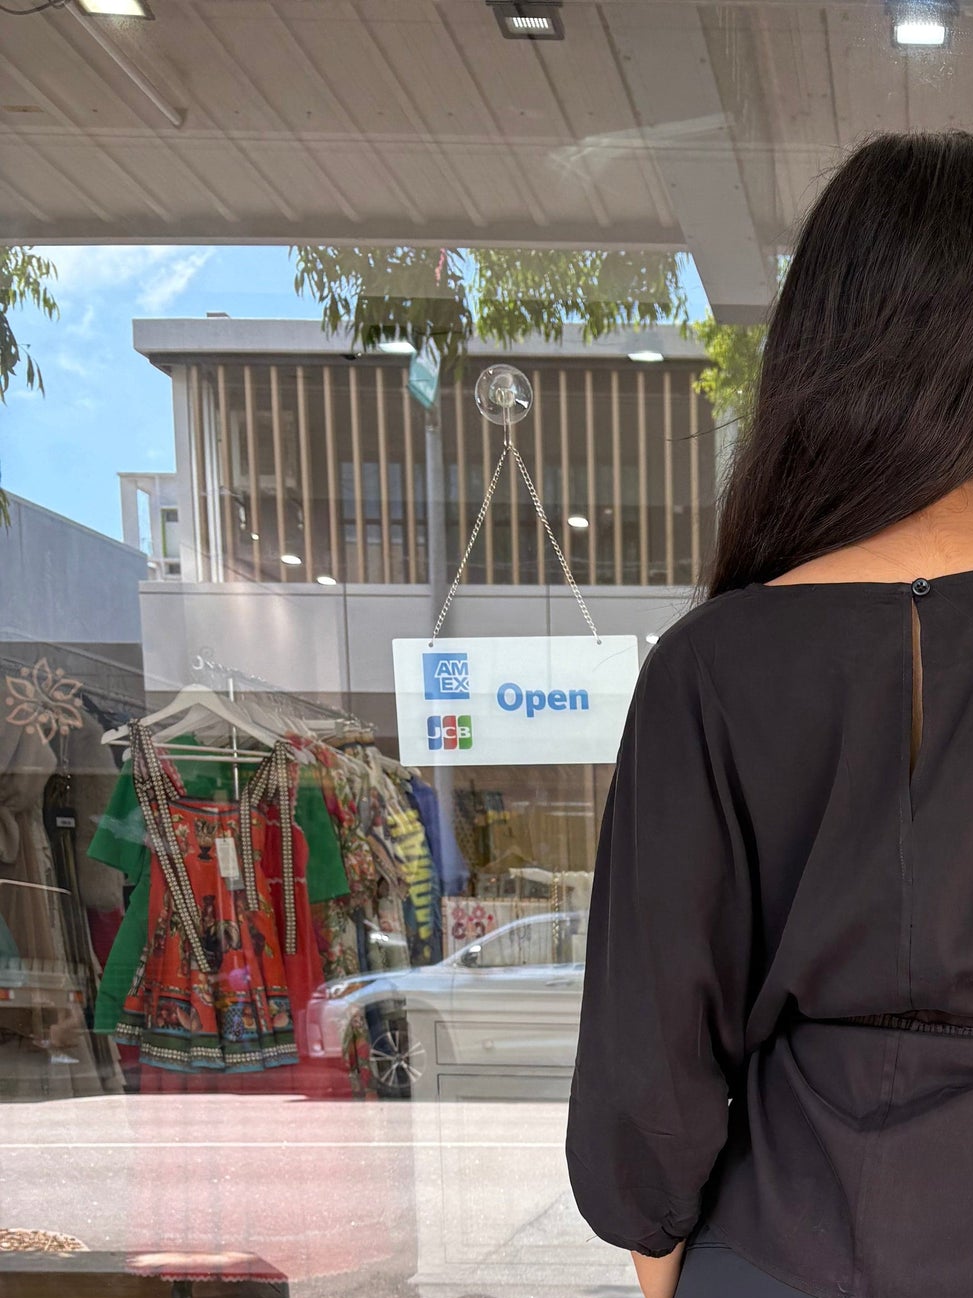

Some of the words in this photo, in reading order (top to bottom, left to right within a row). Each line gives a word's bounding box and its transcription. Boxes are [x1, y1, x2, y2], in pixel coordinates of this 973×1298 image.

[434, 660, 469, 678] AM
[440, 677, 469, 693] EX
[497, 682, 589, 717] Open
